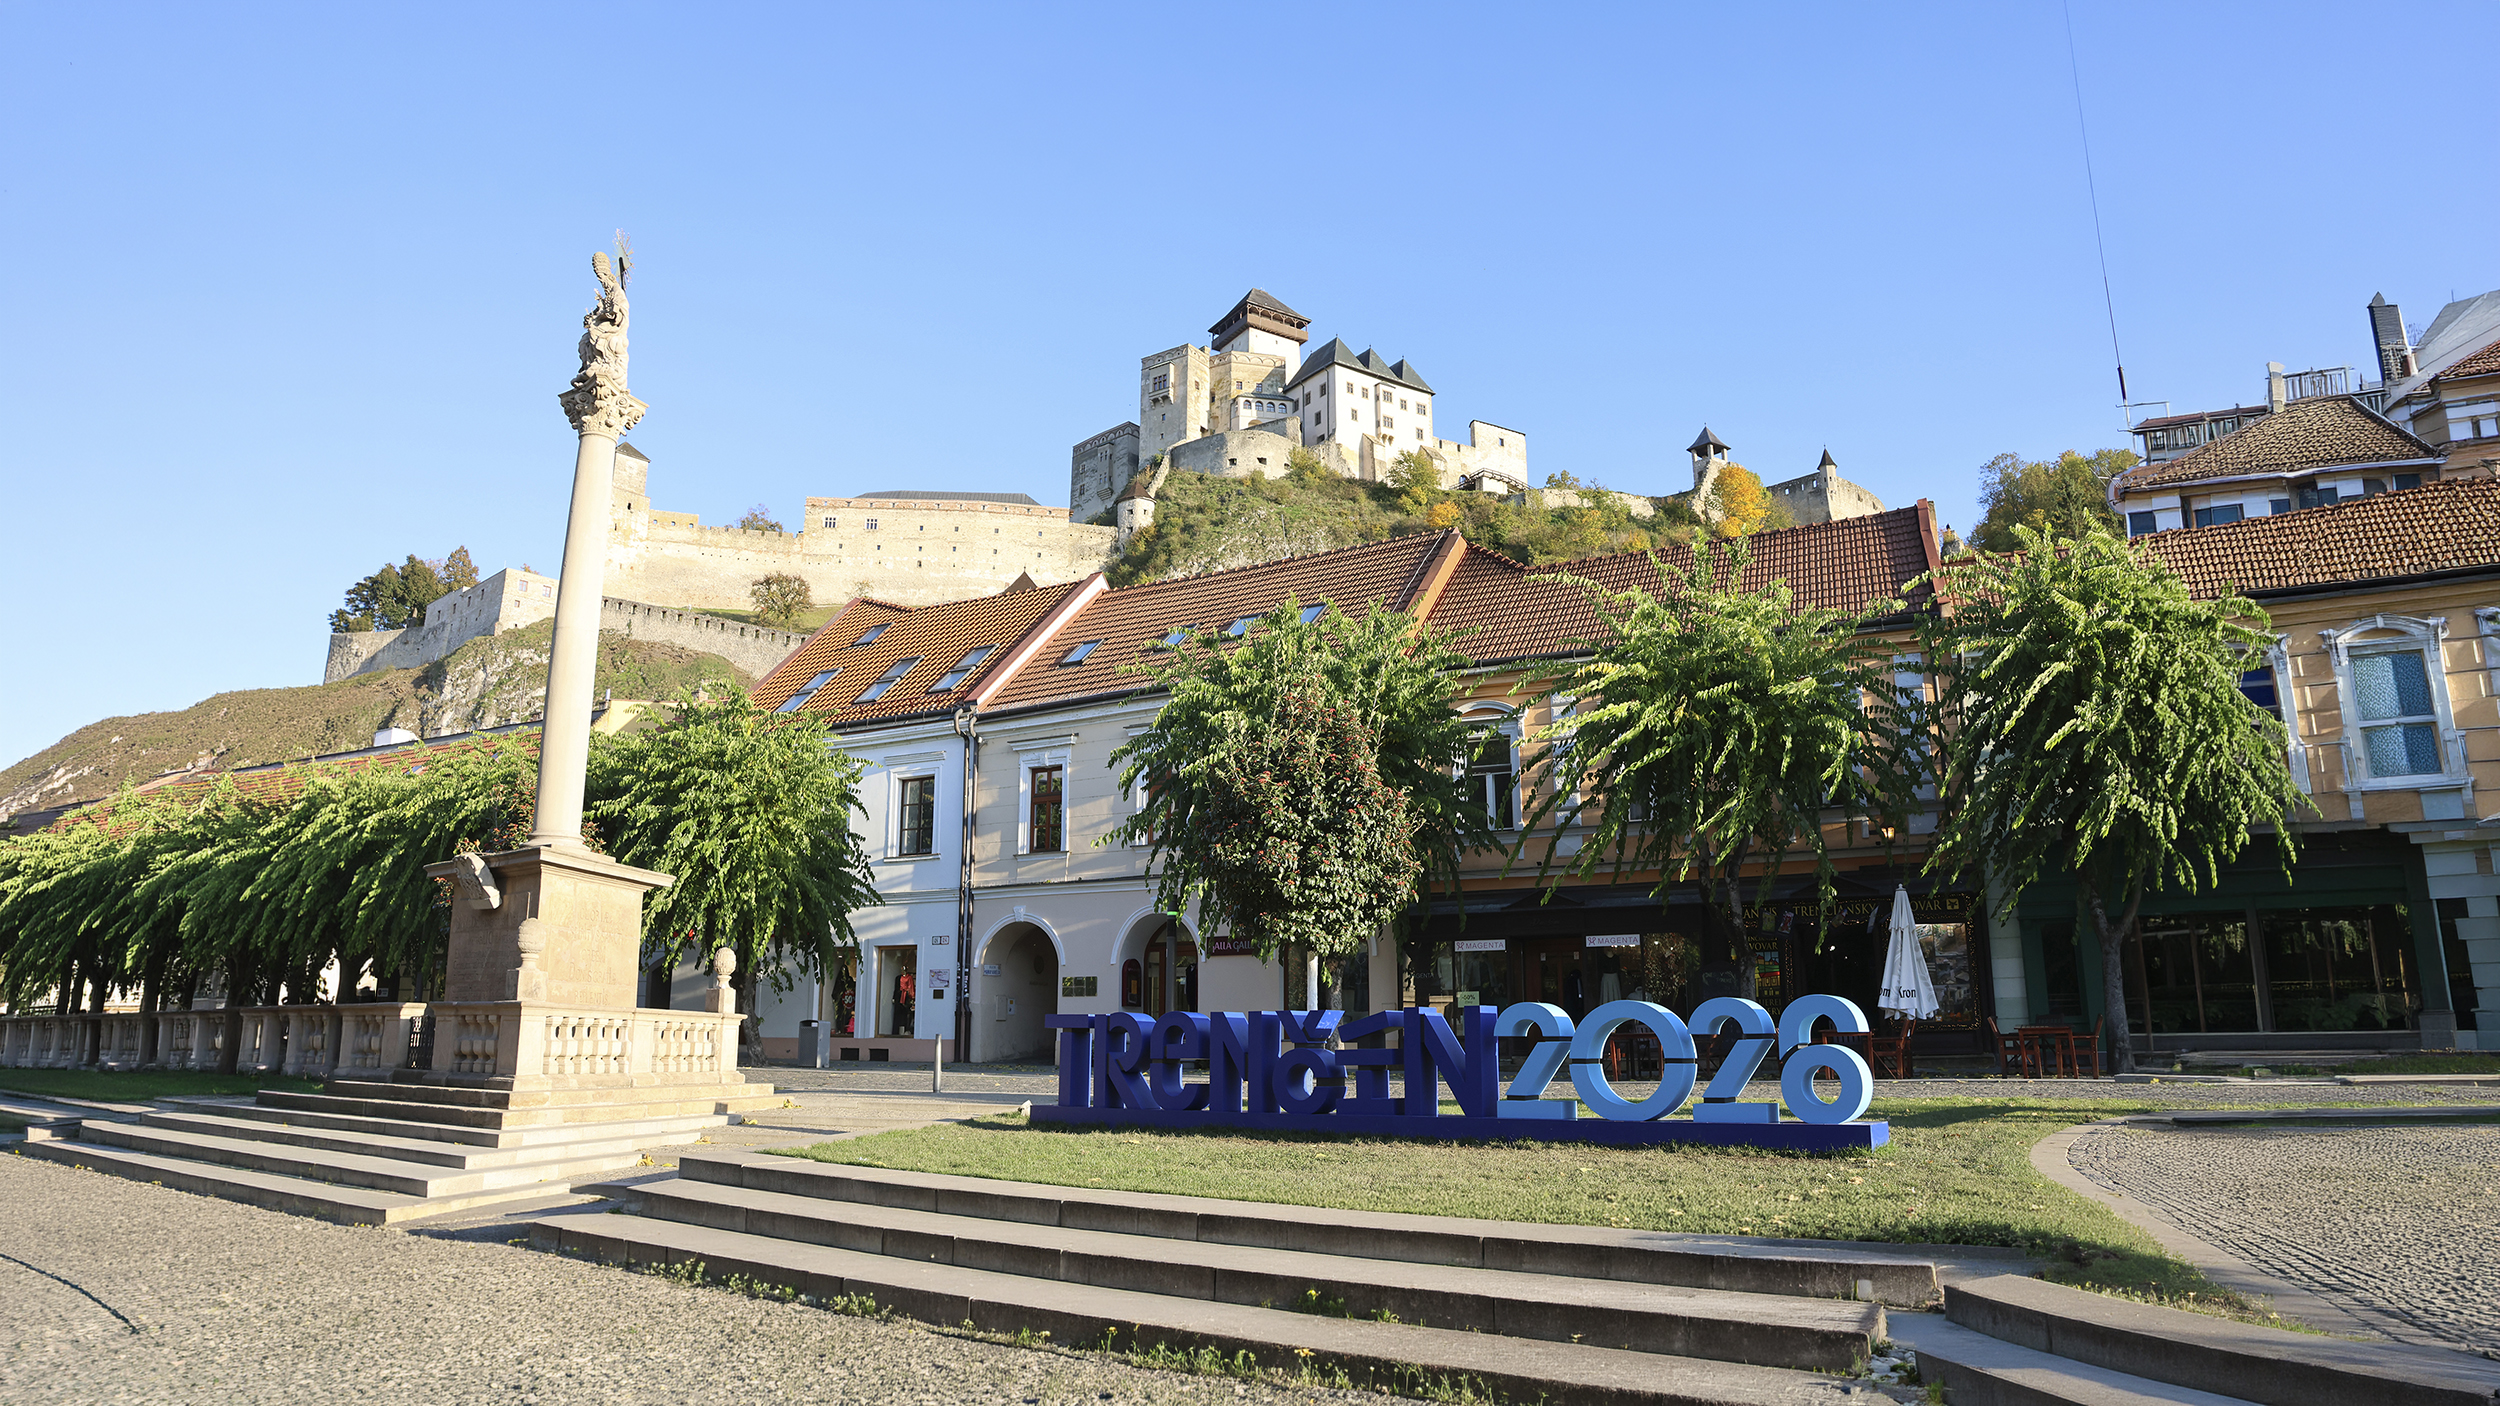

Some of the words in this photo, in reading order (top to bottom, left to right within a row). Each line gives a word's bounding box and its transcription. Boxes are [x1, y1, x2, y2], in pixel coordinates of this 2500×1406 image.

[1597, 936, 1639, 944] MAGENTA
[1465, 941, 1504, 949] MAGENTA
[1494, 994, 1873, 1124] 2026
